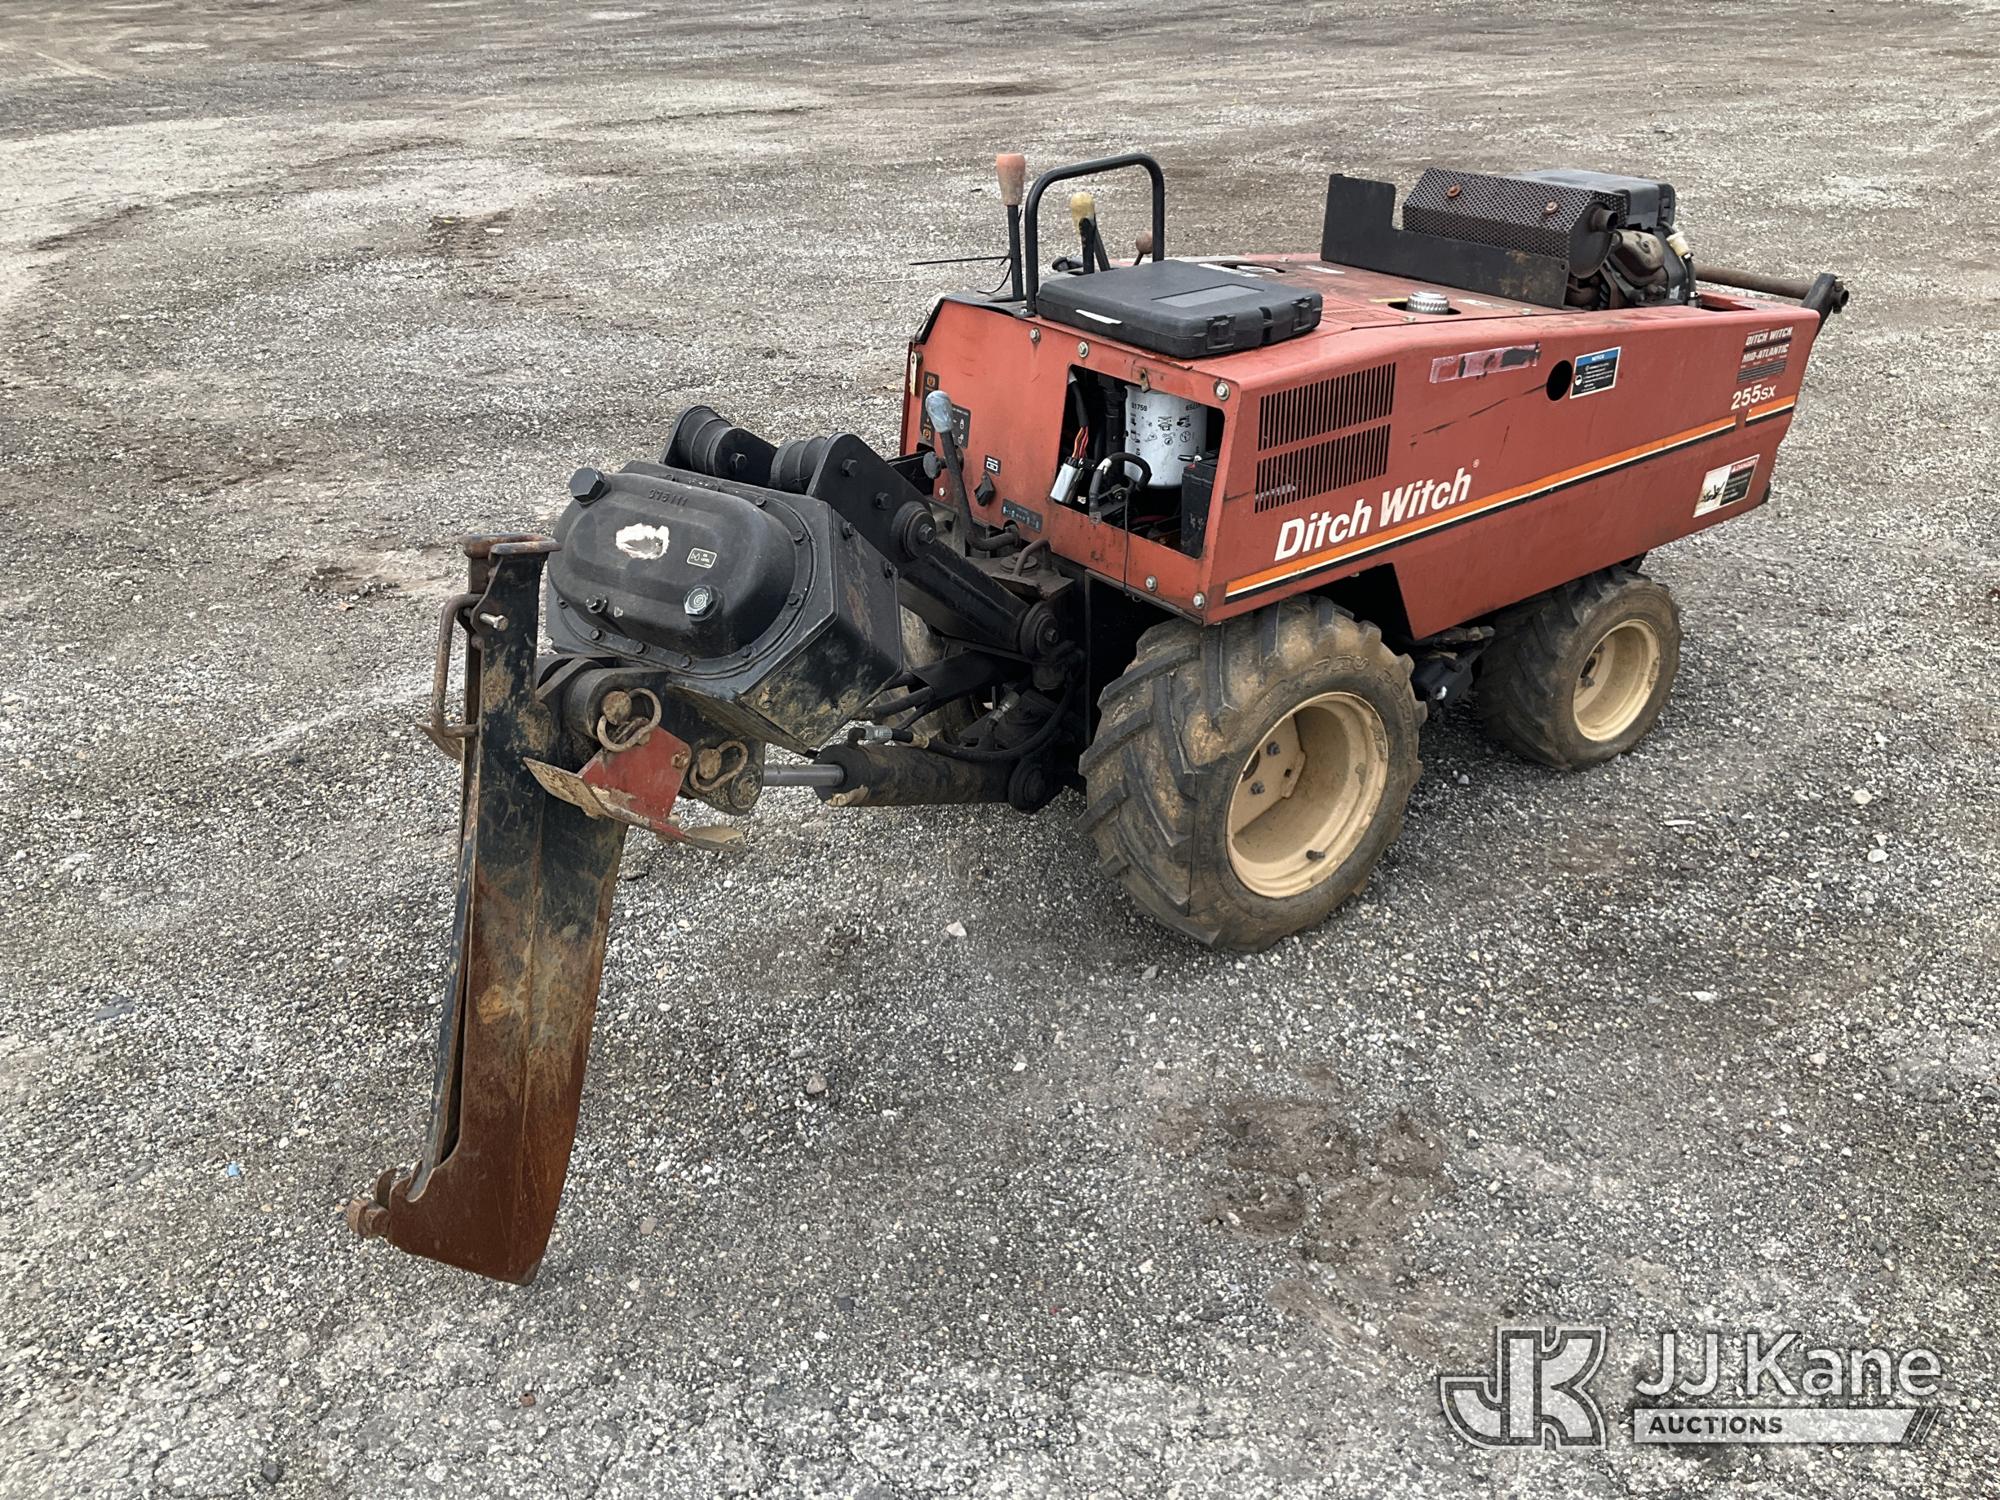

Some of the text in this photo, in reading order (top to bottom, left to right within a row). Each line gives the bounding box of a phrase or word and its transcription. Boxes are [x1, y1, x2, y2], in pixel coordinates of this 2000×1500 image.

[1745, 331, 1769, 346] DITCH
[1769, 326, 1793, 341] WITCH
[1741, 344, 1789, 363] MID-ATLANTIC
[1274, 467, 1472, 561] Ditch Witch
